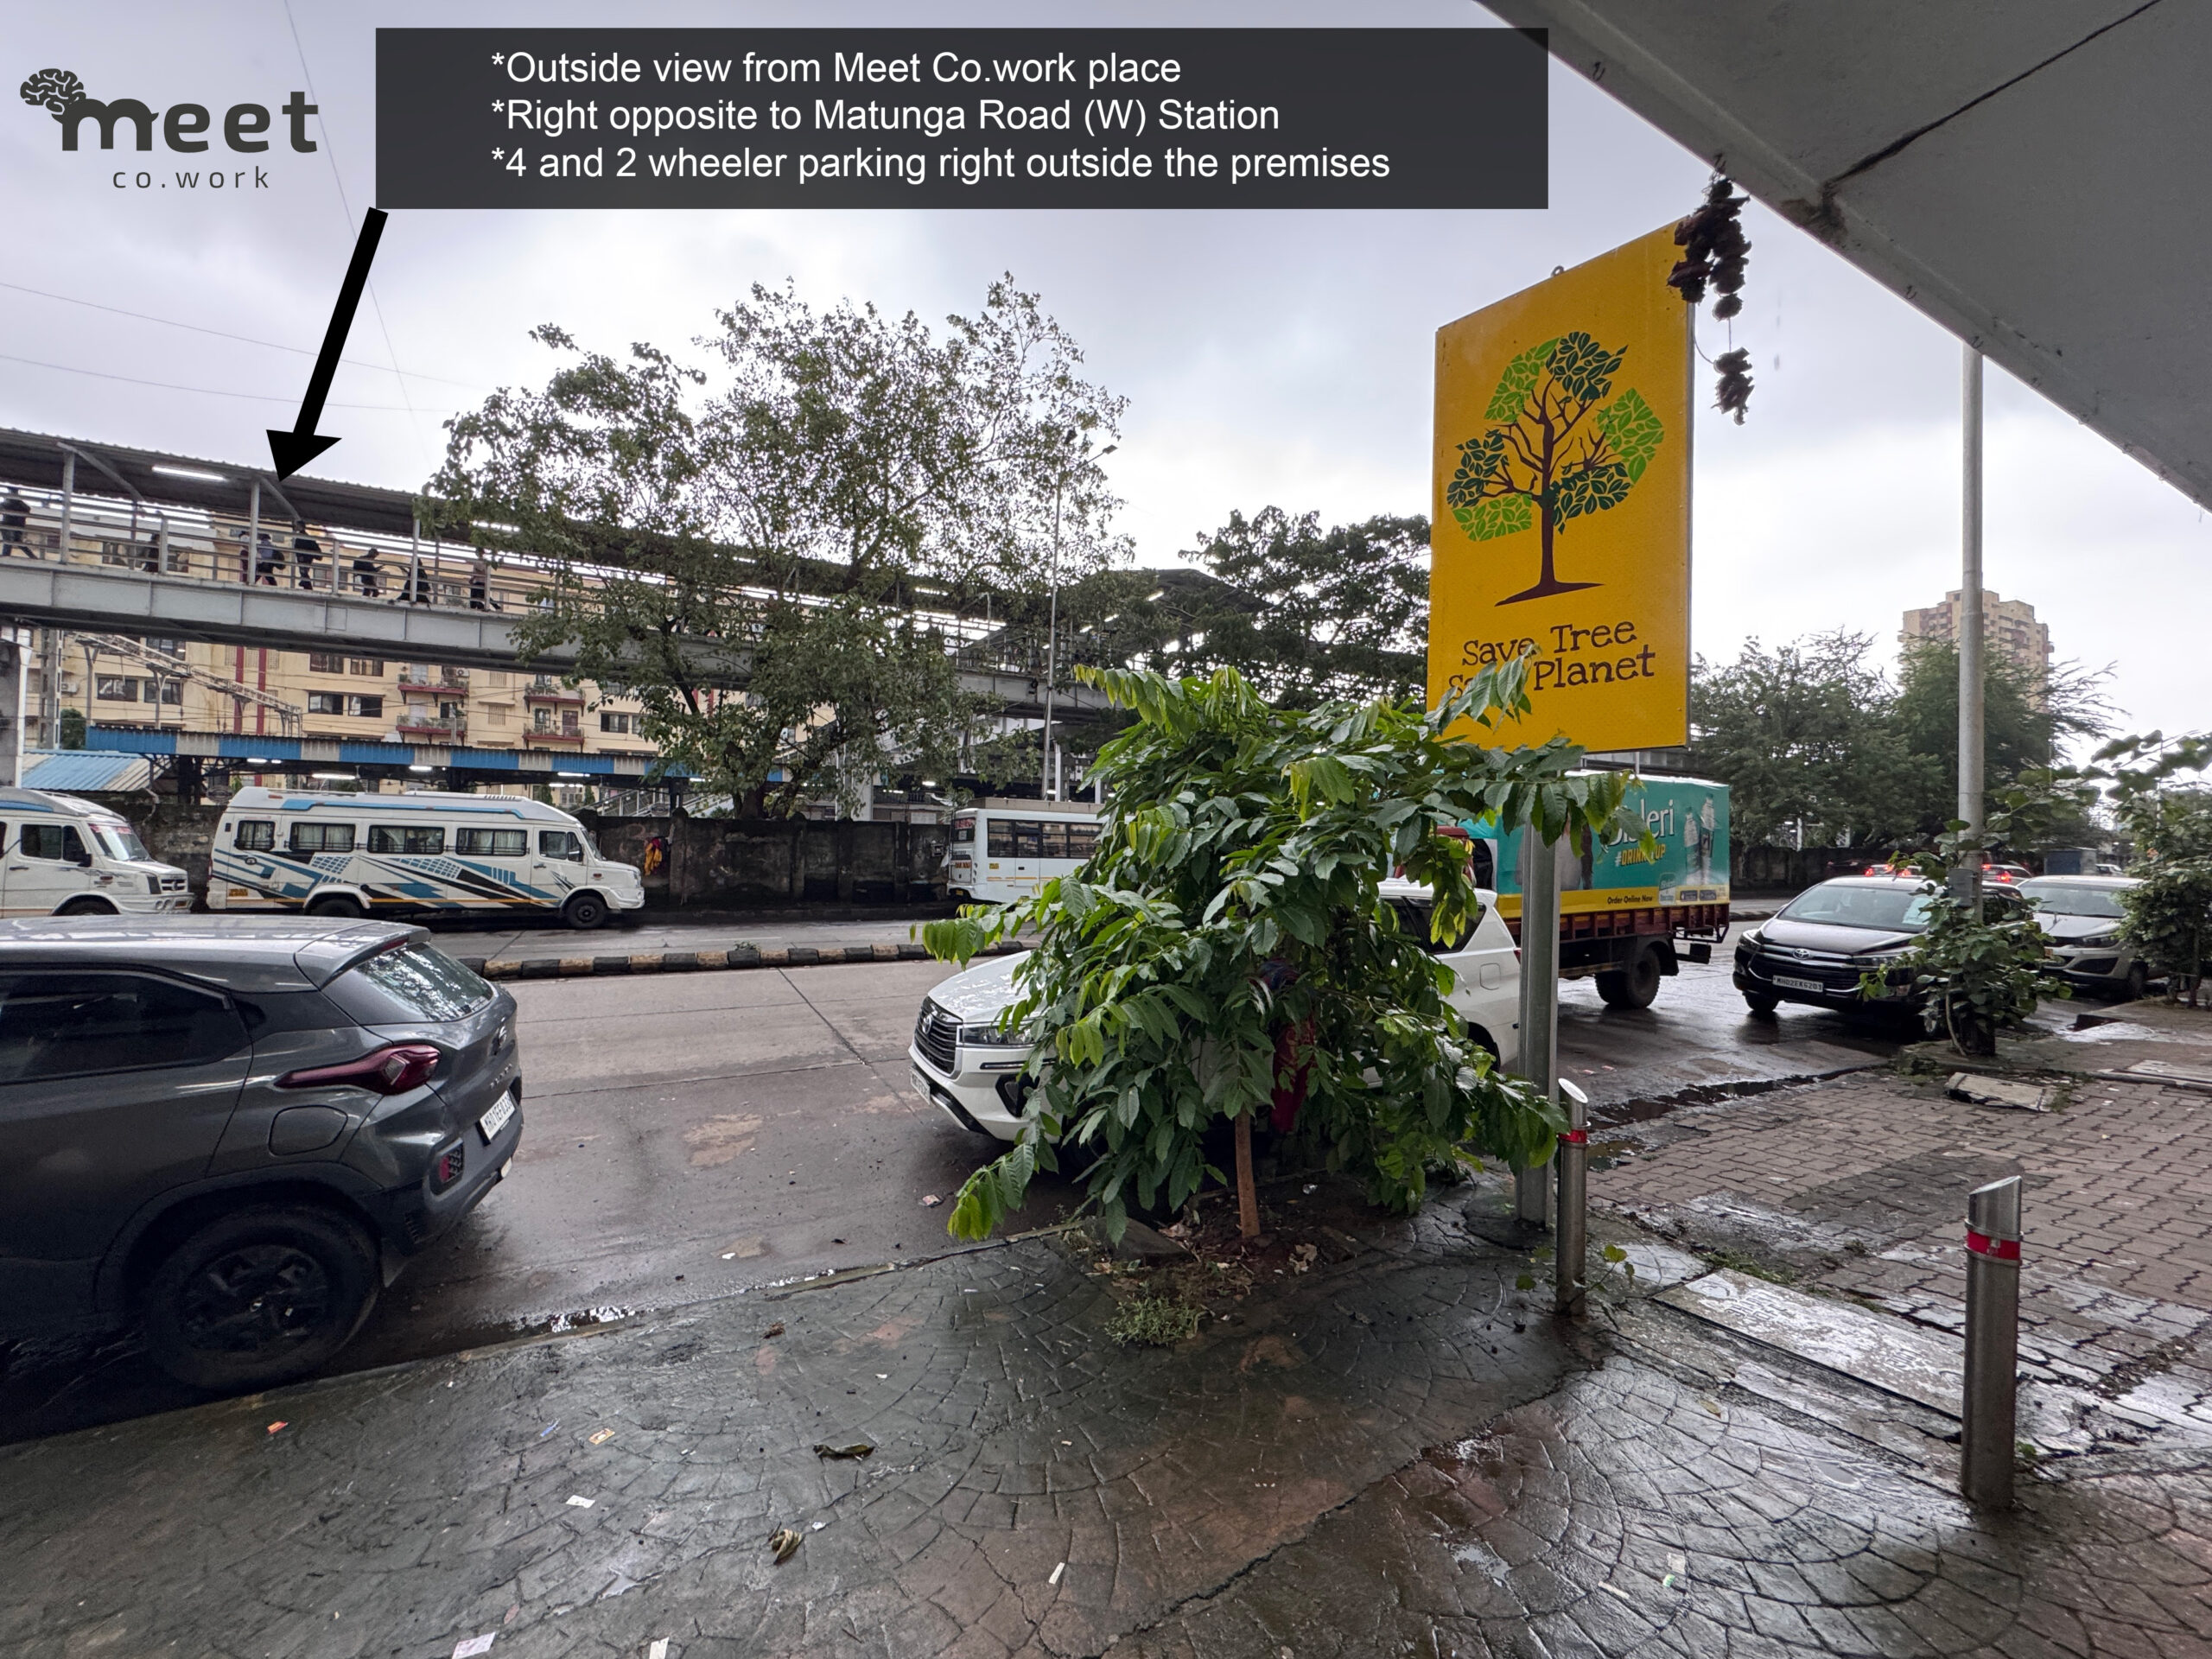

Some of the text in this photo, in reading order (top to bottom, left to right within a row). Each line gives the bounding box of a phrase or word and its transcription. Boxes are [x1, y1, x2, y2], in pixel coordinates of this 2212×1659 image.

[1462, 620, 1637, 666] Save Tree
[1534, 644, 1656, 690] Planet
[1604, 798, 1675, 847] leri
